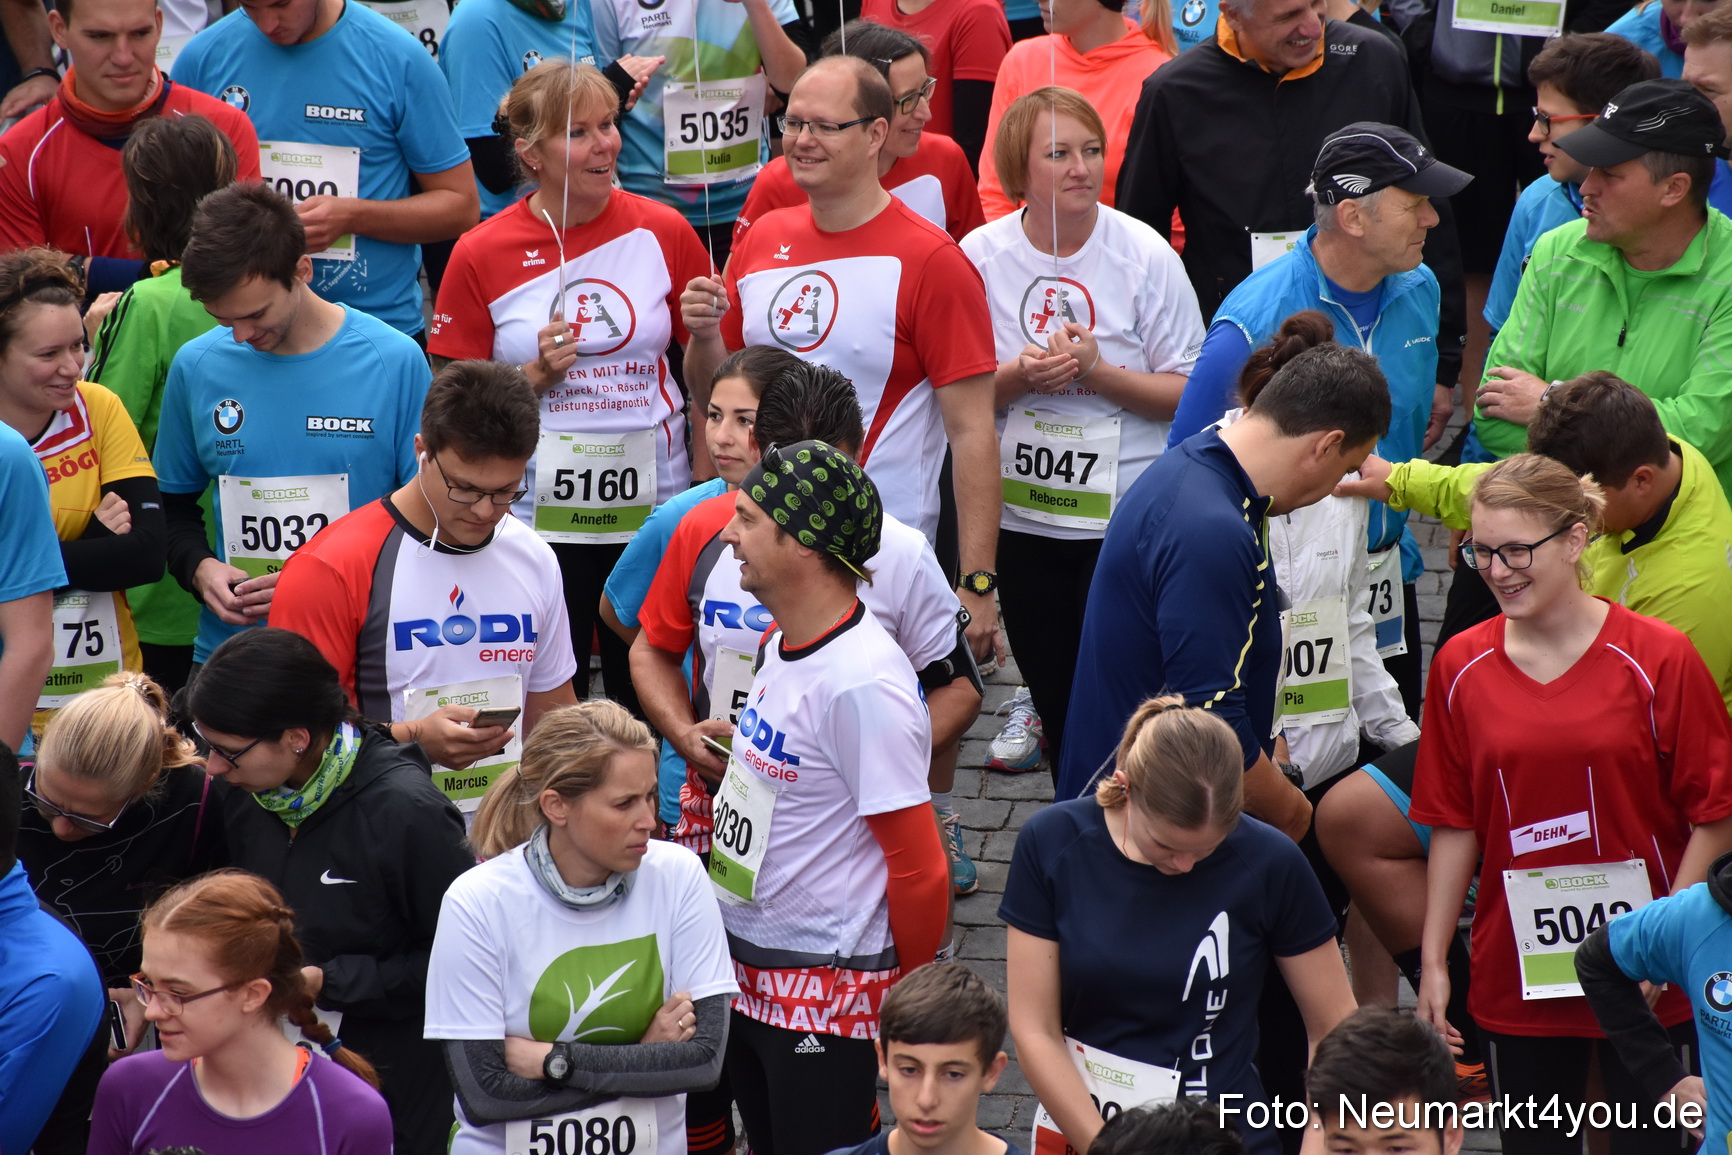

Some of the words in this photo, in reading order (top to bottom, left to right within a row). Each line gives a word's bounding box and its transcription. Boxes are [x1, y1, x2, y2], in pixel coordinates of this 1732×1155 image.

[1491, 2, 1525, 16] Daniel
[641, 11, 671, 25] PARTL
[1330, 44, 1358, 52] GORE
[305, 105, 366, 121] BOCK
[681, 107, 749, 144] 5035
[282, 153, 322, 165] BOCK
[707, 152, 731, 166] Julia
[522, 259, 546, 267] erima
[566, 369, 587, 380] EN
[593, 365, 619, 378] MIT
[625, 362, 657, 375] HER
[549, 390, 563, 398] Dr.
[566, 385, 593, 397] Heck
[602, 384, 616, 393] Dr.
[617, 381, 649, 392] Röschl
[549, 396, 650, 412] Leistungsdiagnostik
[307, 417, 373, 432] BOCK
[1043, 423, 1083, 436] BOCK
[216, 440, 245, 449] PARTL
[585, 444, 625, 454] BOCK
[1015, 442, 1099, 485] 5047
[553, 467, 639, 502] 5160
[263, 488, 309, 499] BOCK
[1030, 489, 1078, 508] Rebecca
[571, 512, 618, 525] Annette
[1368, 579, 1393, 615] 73
[54, 619, 104, 658] 75
[1284, 637, 1333, 678] 07
[45, 672, 83, 686] athrin
[451, 691, 489, 705] BOCK
[1285, 692, 1304, 705] Pia
[745, 749, 799, 783] energie
[444, 775, 488, 791] Marcus
[1534, 825, 1568, 843] DEHN
[1560, 875, 1608, 888] BOCK
[795, 1045, 826, 1054] adidas
[1093, 1063, 1135, 1086] BOCK
[529, 1115, 637, 1155] 5080
